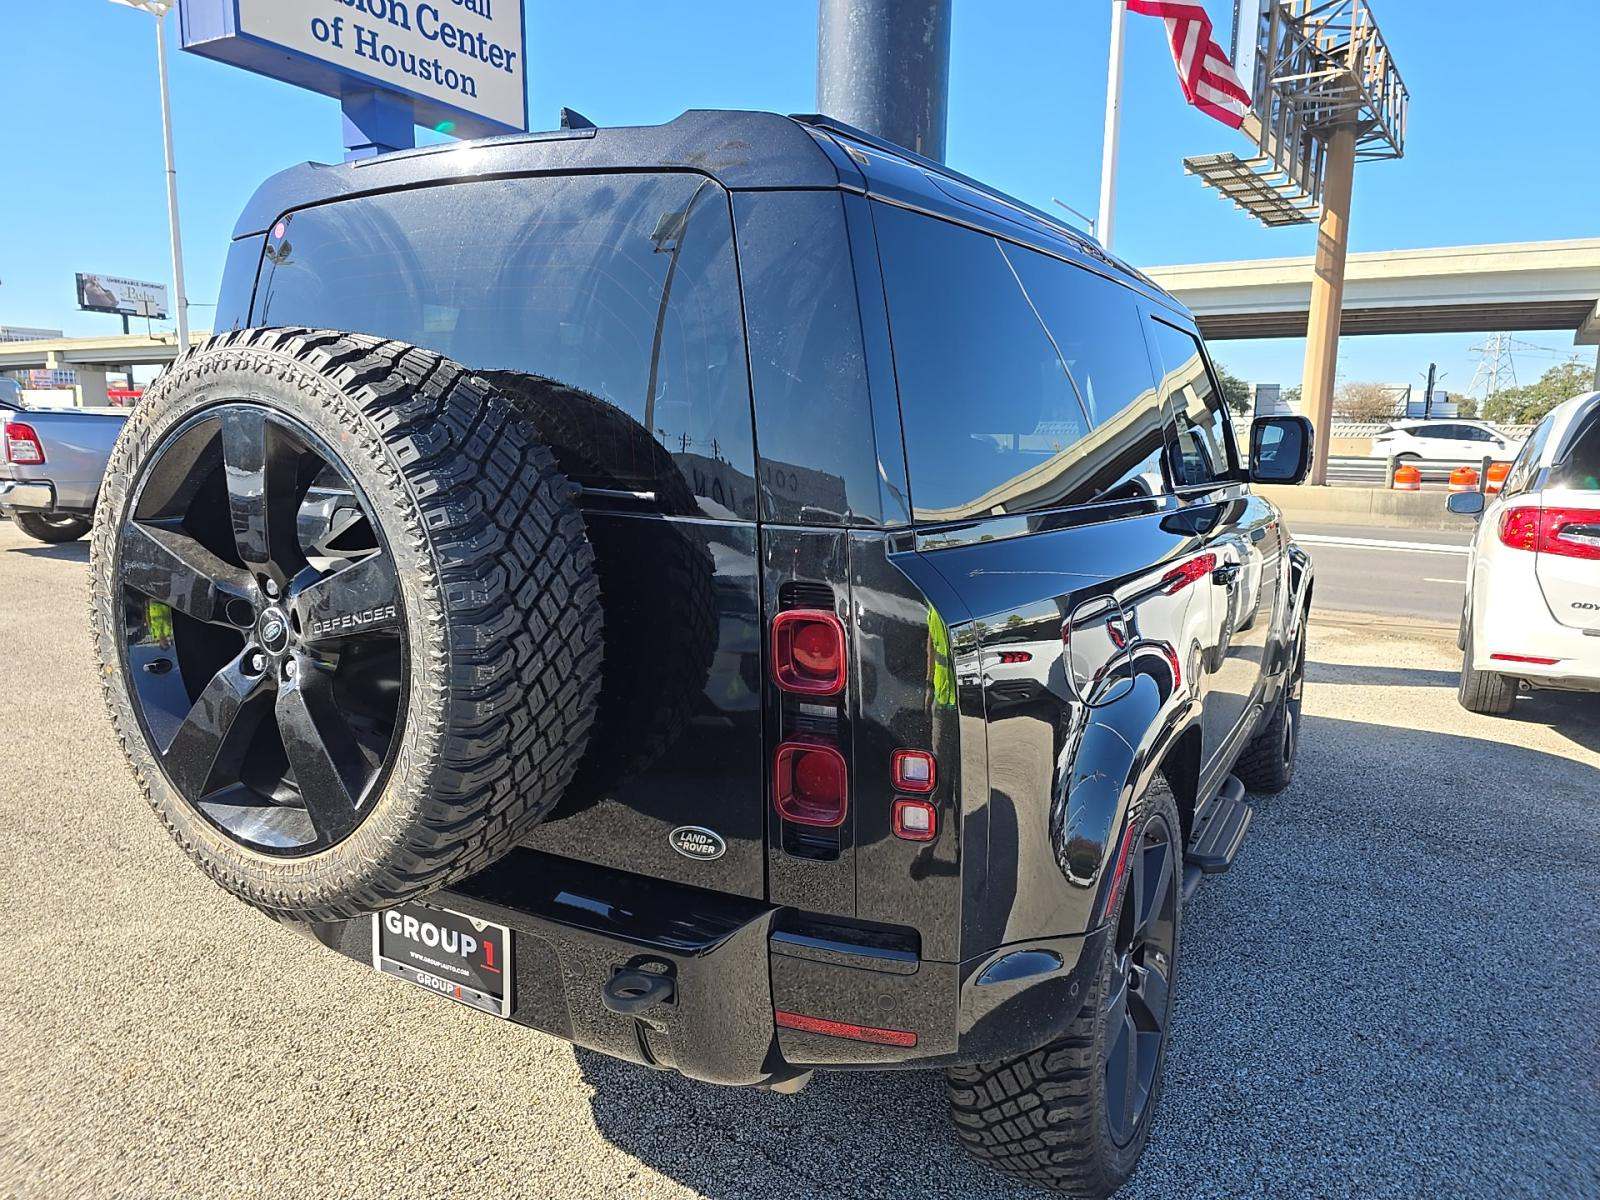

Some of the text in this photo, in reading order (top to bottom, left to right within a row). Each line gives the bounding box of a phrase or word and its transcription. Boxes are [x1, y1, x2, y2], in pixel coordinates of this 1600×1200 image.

[416, 3, 517, 74] Center
[311, 16, 478, 98] of Houston
[313, 605, 397, 634] DEFENDER
[680, 832, 707, 844] LAND
[682, 841, 716, 854] ROVER
[385, 909, 478, 957] GROUP
[416, 973, 464, 1001] GROUP 1
